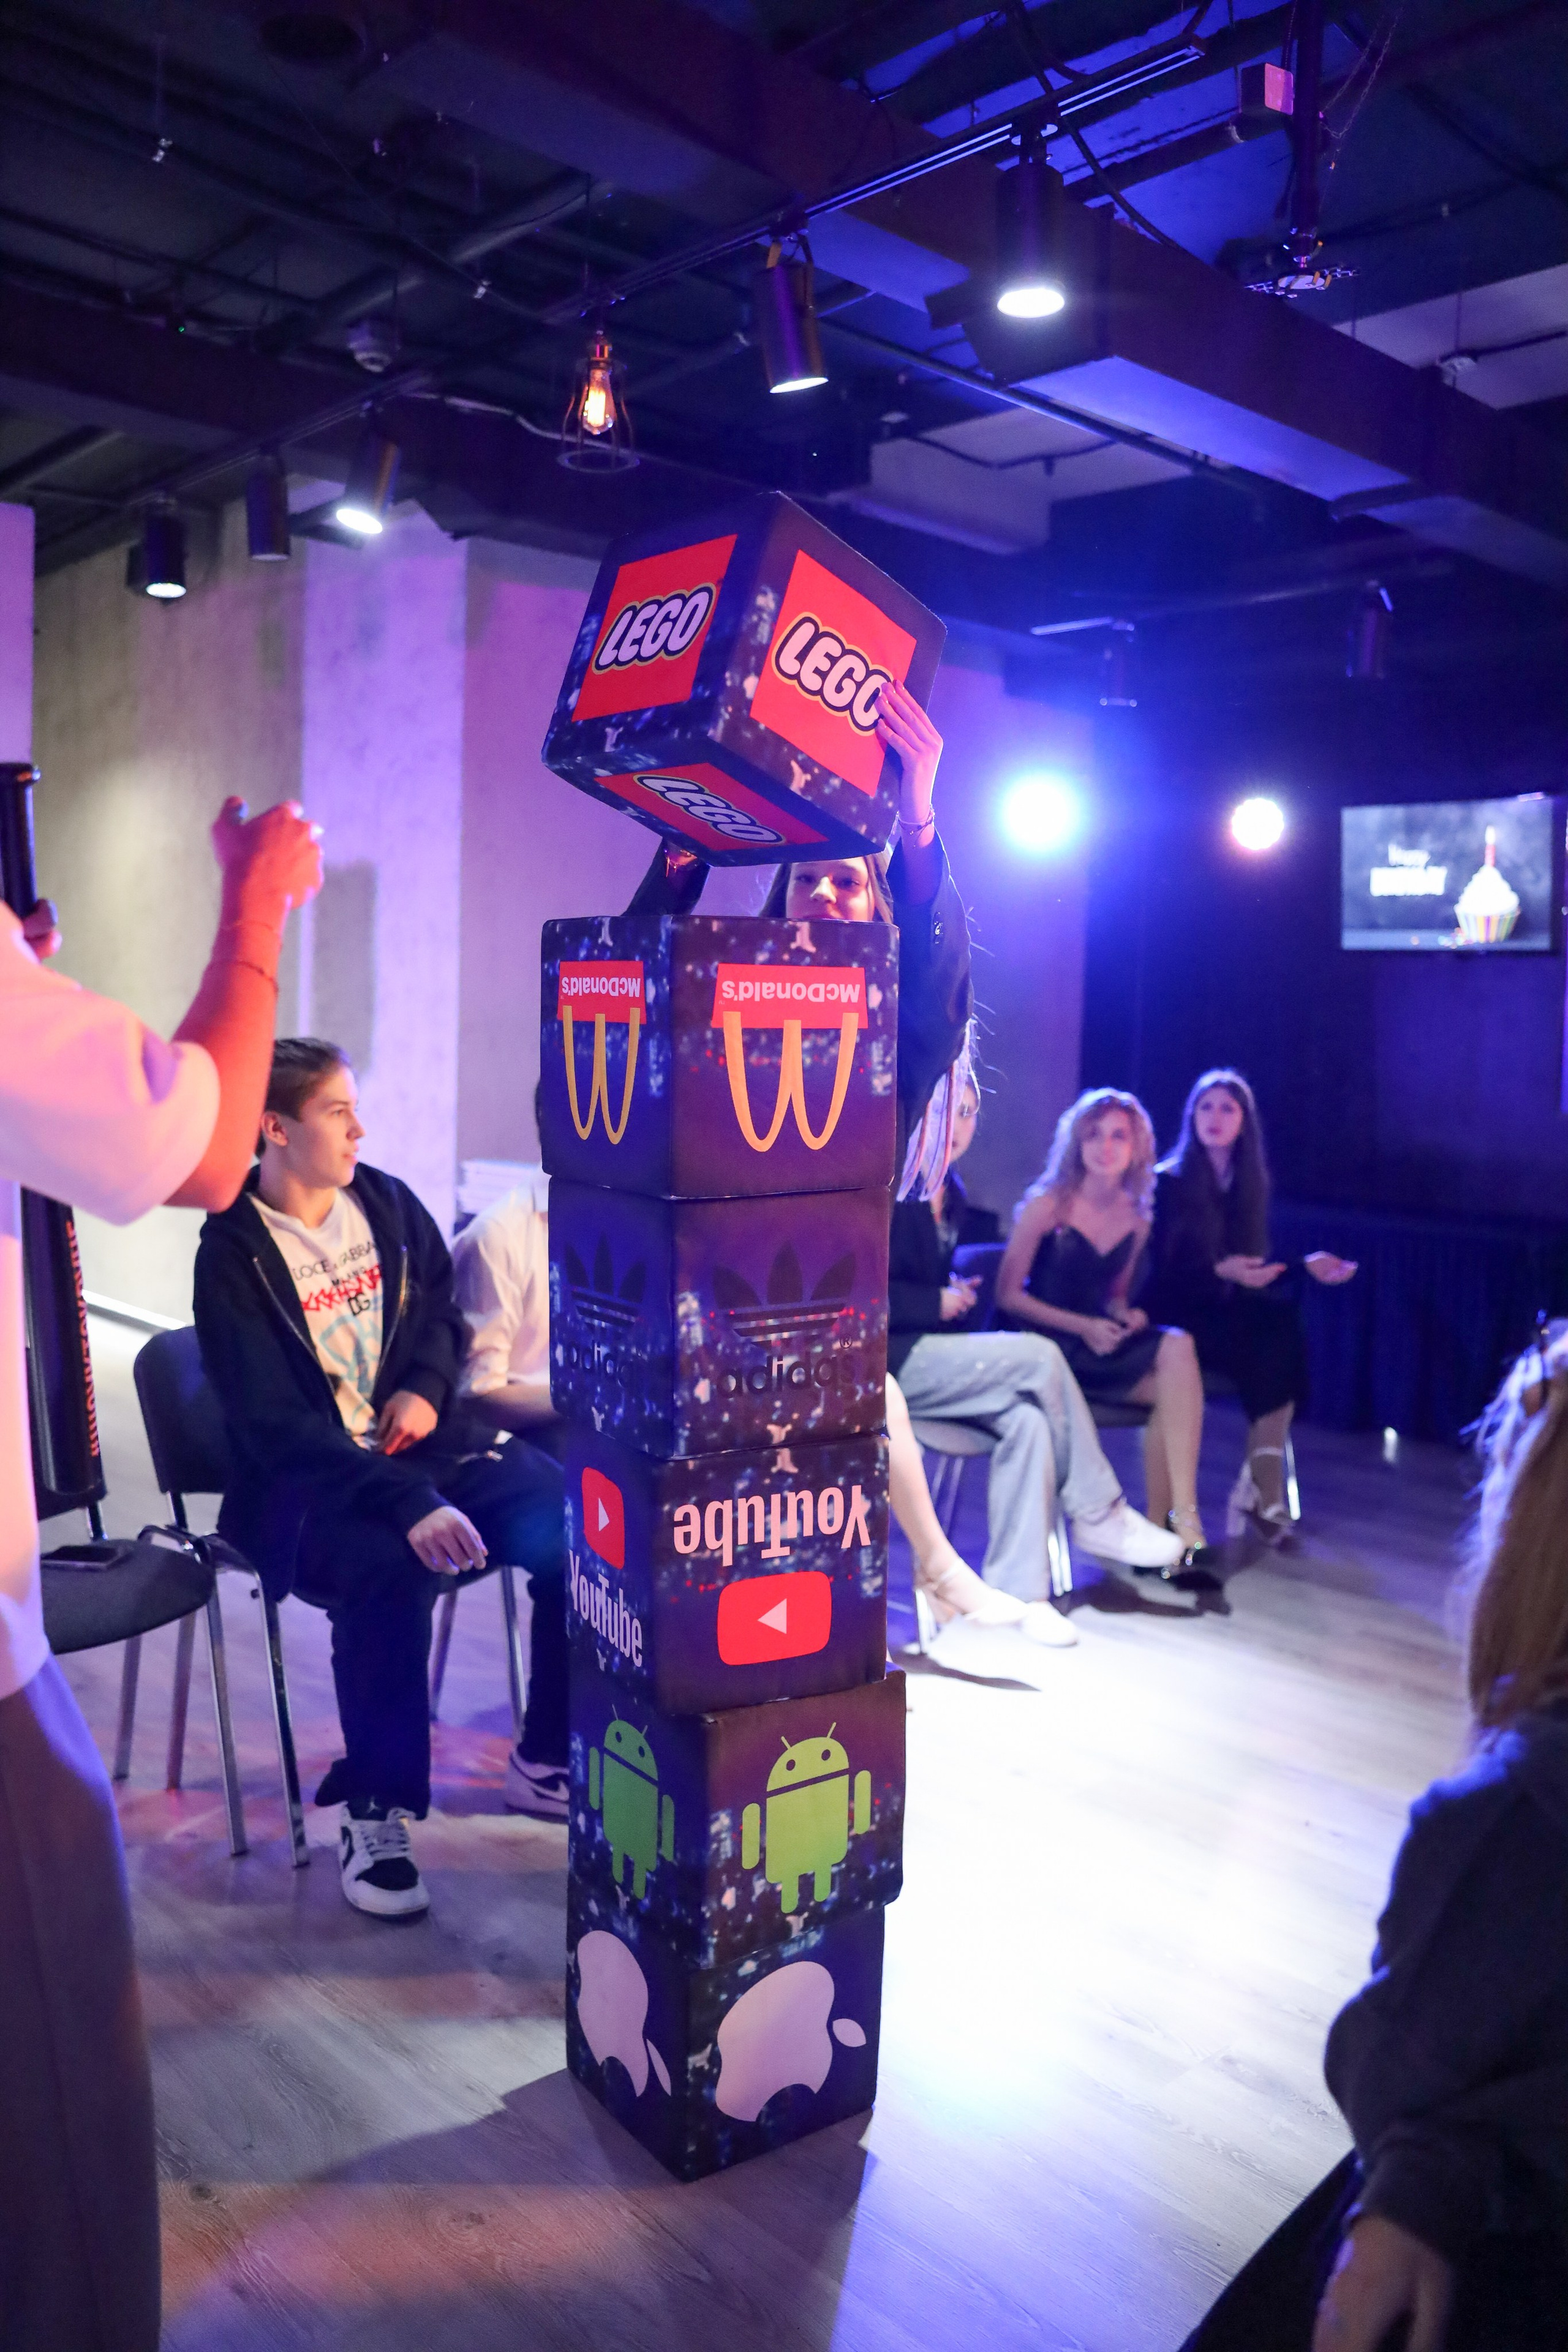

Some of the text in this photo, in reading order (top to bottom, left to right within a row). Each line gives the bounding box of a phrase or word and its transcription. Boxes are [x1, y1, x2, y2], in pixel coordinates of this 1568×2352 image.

[595, 586, 714, 671] LEGO
[774, 616, 893, 733] LEGO
[636, 775, 785, 844] LEGO
[562, 976, 641, 998] McDonald's
[722, 981, 860, 1003] McDonald's
[716, 1351, 855, 1400] adidas
[674, 1484, 872, 1567] YouTube
[568, 1549, 643, 1668] YouTube
